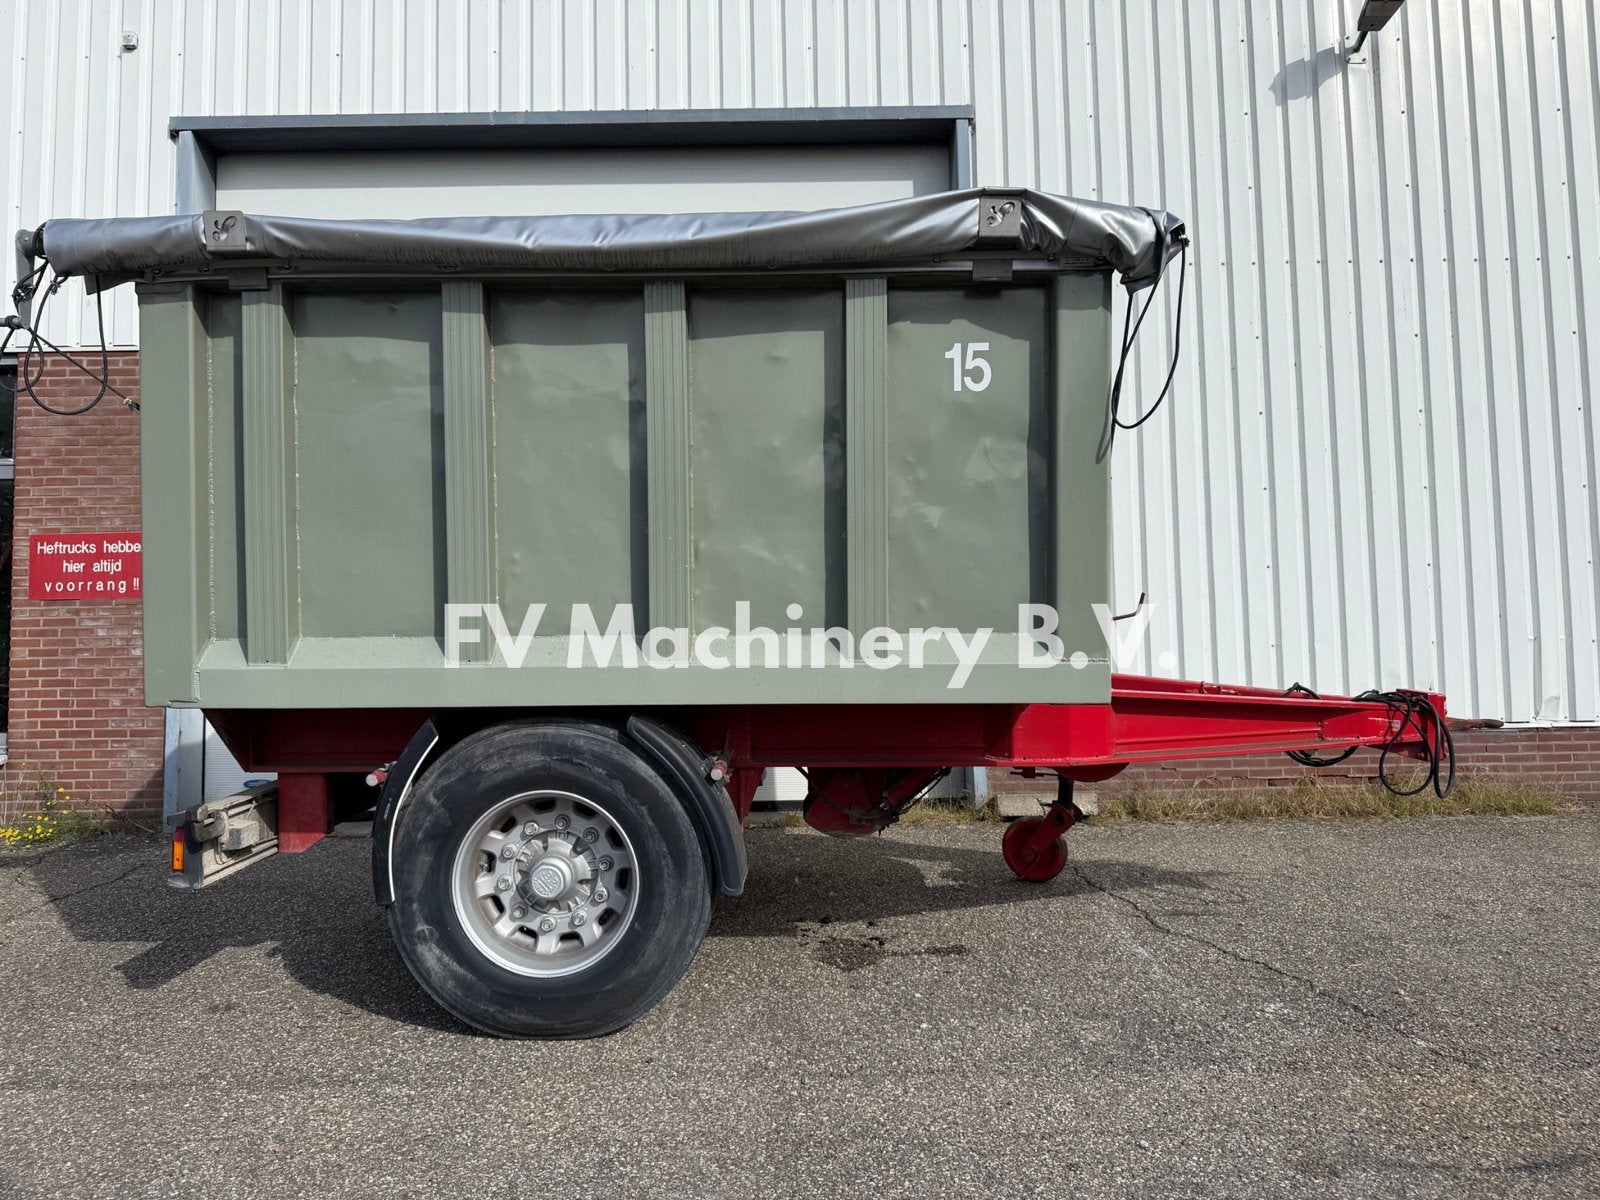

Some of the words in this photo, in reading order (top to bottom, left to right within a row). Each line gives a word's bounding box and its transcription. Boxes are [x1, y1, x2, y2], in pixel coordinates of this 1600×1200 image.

[944, 342, 992, 392] 15
[37, 541, 97, 555] Heftrucks
[103, 540, 142, 553] hebbe
[62, 560, 86, 573] hier
[92, 559, 122, 575] altijd
[44, 580, 127, 593] voorrang
